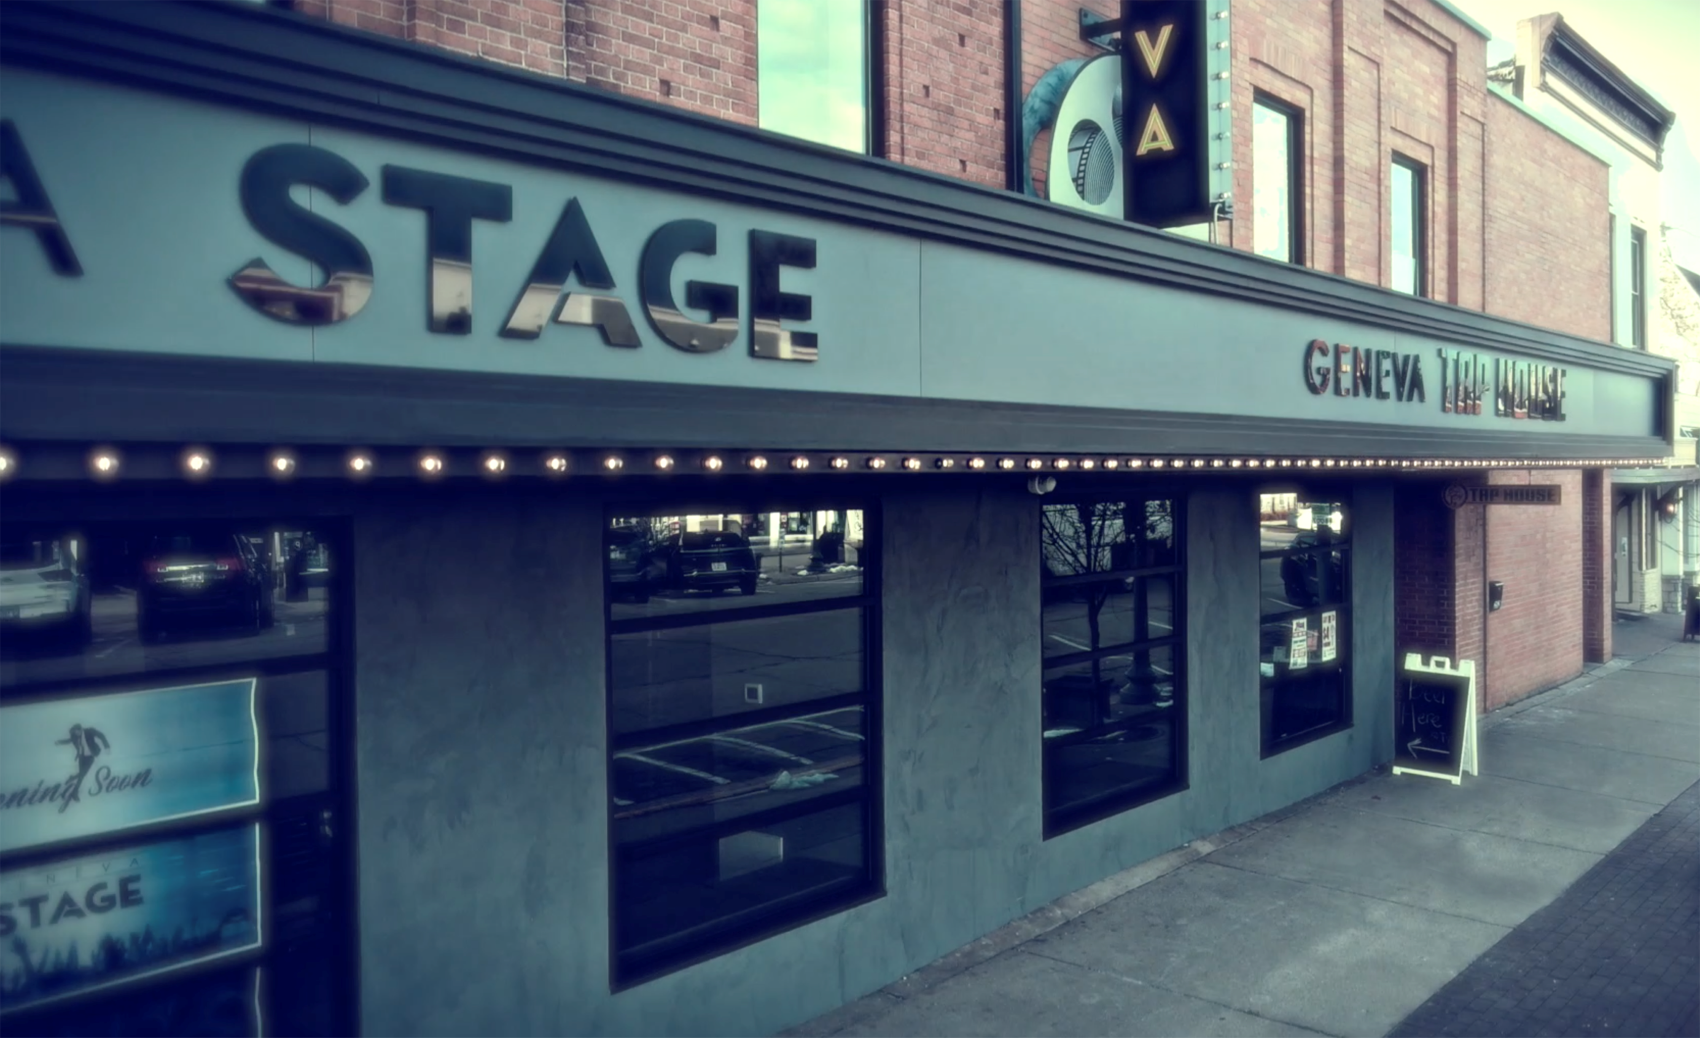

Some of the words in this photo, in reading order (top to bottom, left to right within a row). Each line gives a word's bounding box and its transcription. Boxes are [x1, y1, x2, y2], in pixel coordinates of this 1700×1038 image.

[226, 142, 819, 362] STAGE
[1304, 338, 1426, 403] GENEVA
[1438, 347, 1490, 416] TAP
[1495, 357, 1567, 422] HOUSE
[1469, 487, 1500, 503] TAP
[1503, 487, 1557, 503] HOUSE
[1401, 702, 1443, 733] Here
[88, 765, 154, 797] Soon
[0, 874, 144, 936] STAGE
